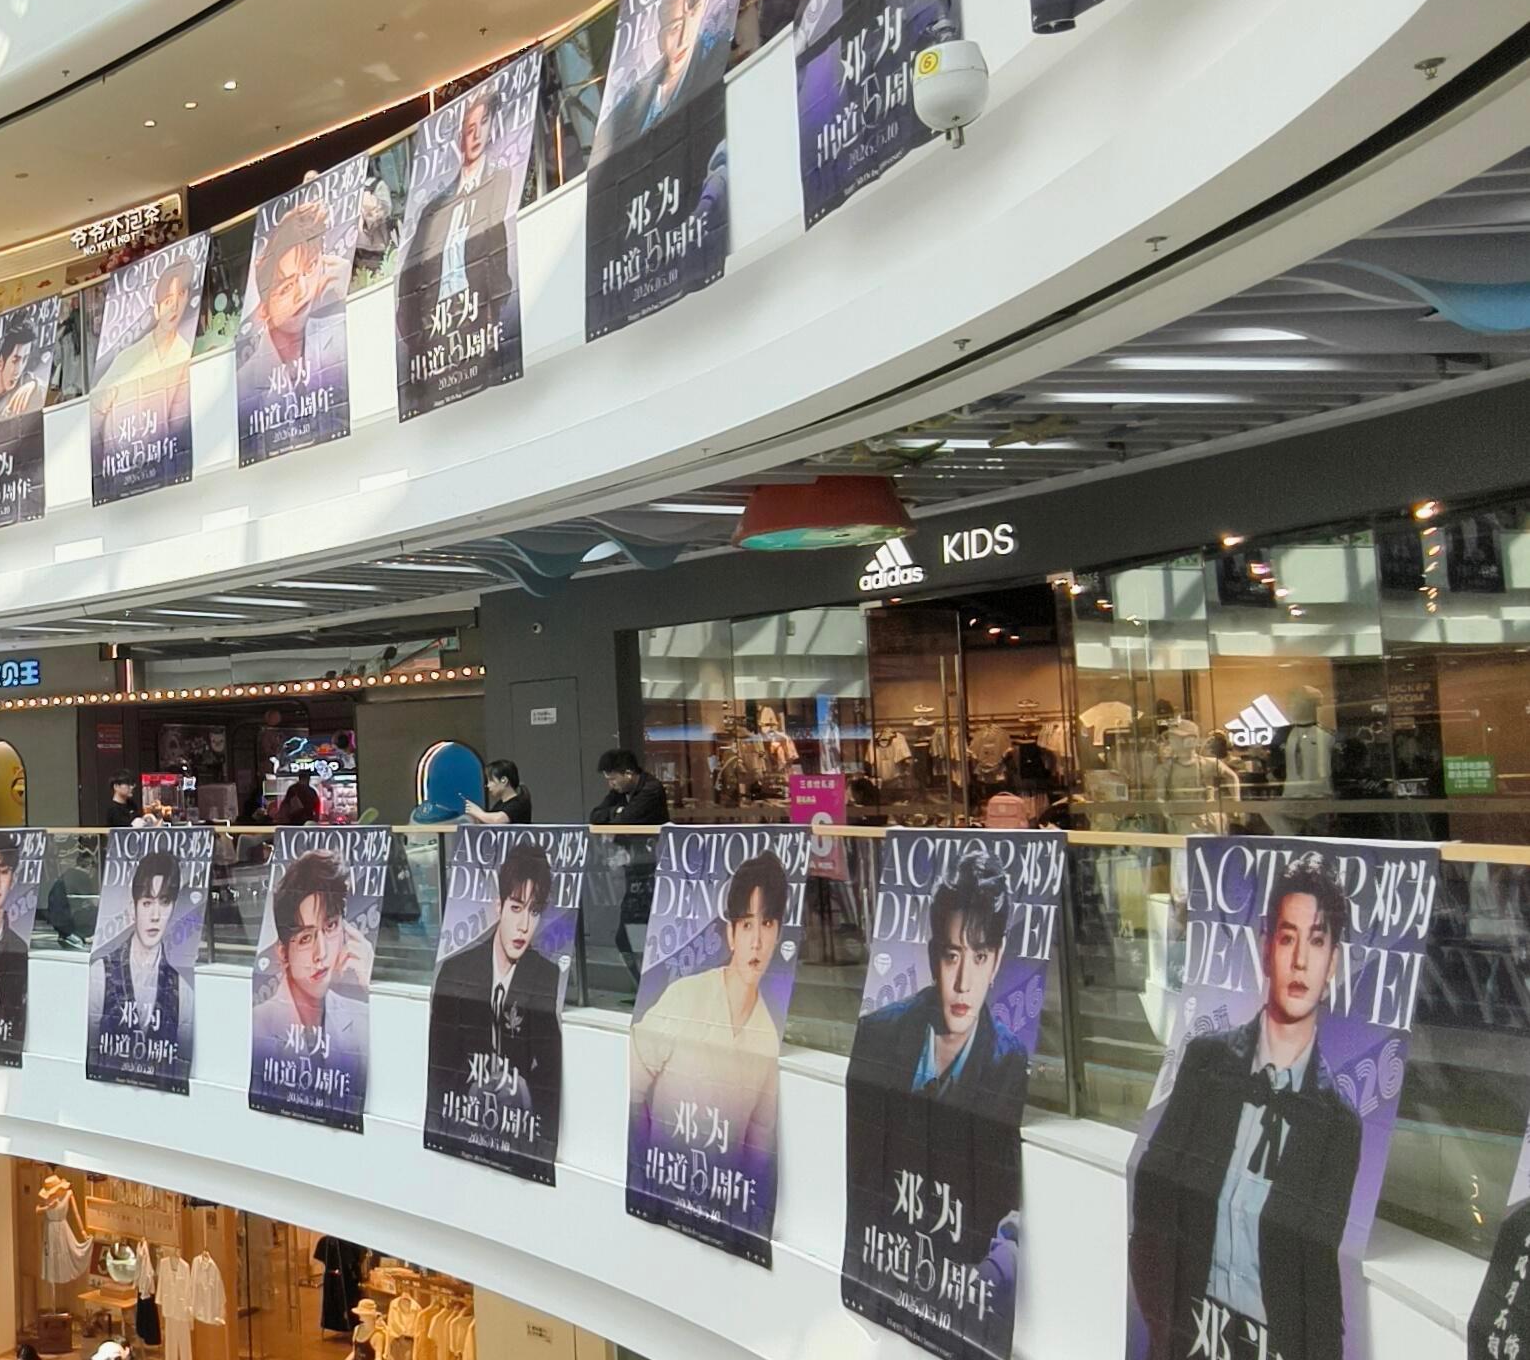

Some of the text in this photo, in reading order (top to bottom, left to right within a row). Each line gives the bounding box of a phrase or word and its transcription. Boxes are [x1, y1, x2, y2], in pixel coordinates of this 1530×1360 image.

[841, 4, 904, 97] 邓为
[71, 201, 162, 249] 爷爷不泡茶
[625, 173, 681, 242] 邓为
[429, 285, 480, 340] 邓为
[268, 358, 312, 396] 邓为
[118, 408, 157, 442] 邓为
[859, 523, 1014, 591] adidas KIDS
[106, 831, 189, 859] ACTOR
[1370, 858, 1436, 941] 邓为
[119, 1001, 161, 1030] 邓为
[284, 1024, 331, 1060] 邓为
[466, 1051, 519, 1097] 邓为
[672, 1100, 731, 1155] 邓为
[890, 1168, 964, 1243] 邓为
